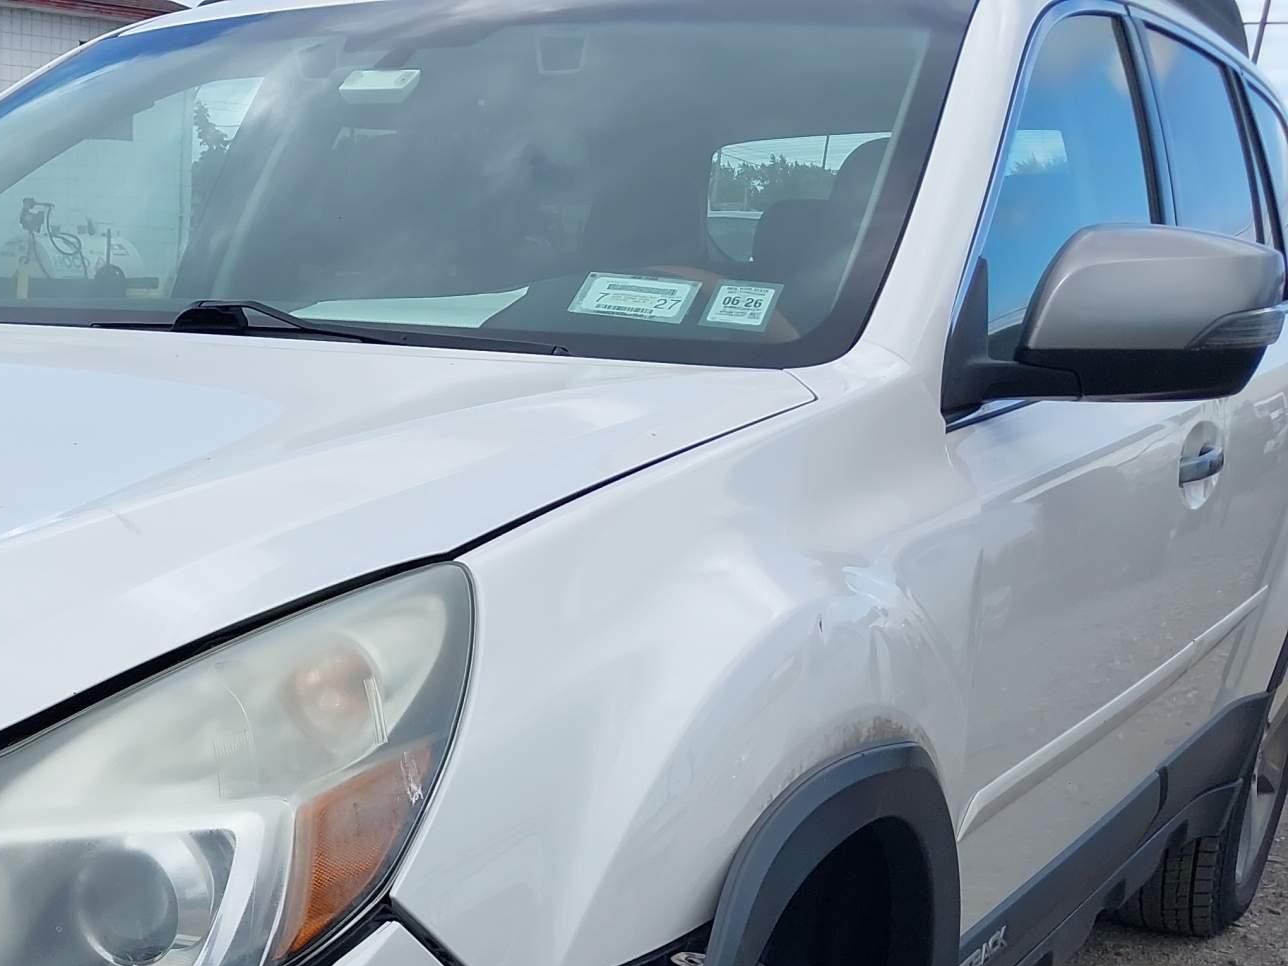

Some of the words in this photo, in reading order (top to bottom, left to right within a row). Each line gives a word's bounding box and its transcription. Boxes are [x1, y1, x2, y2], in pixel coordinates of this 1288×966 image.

[596, 292, 609, 302] 7
[654, 298, 682, 311] 27
[722, 296, 741, 306] 06
[743, 297, 764, 308] 26
